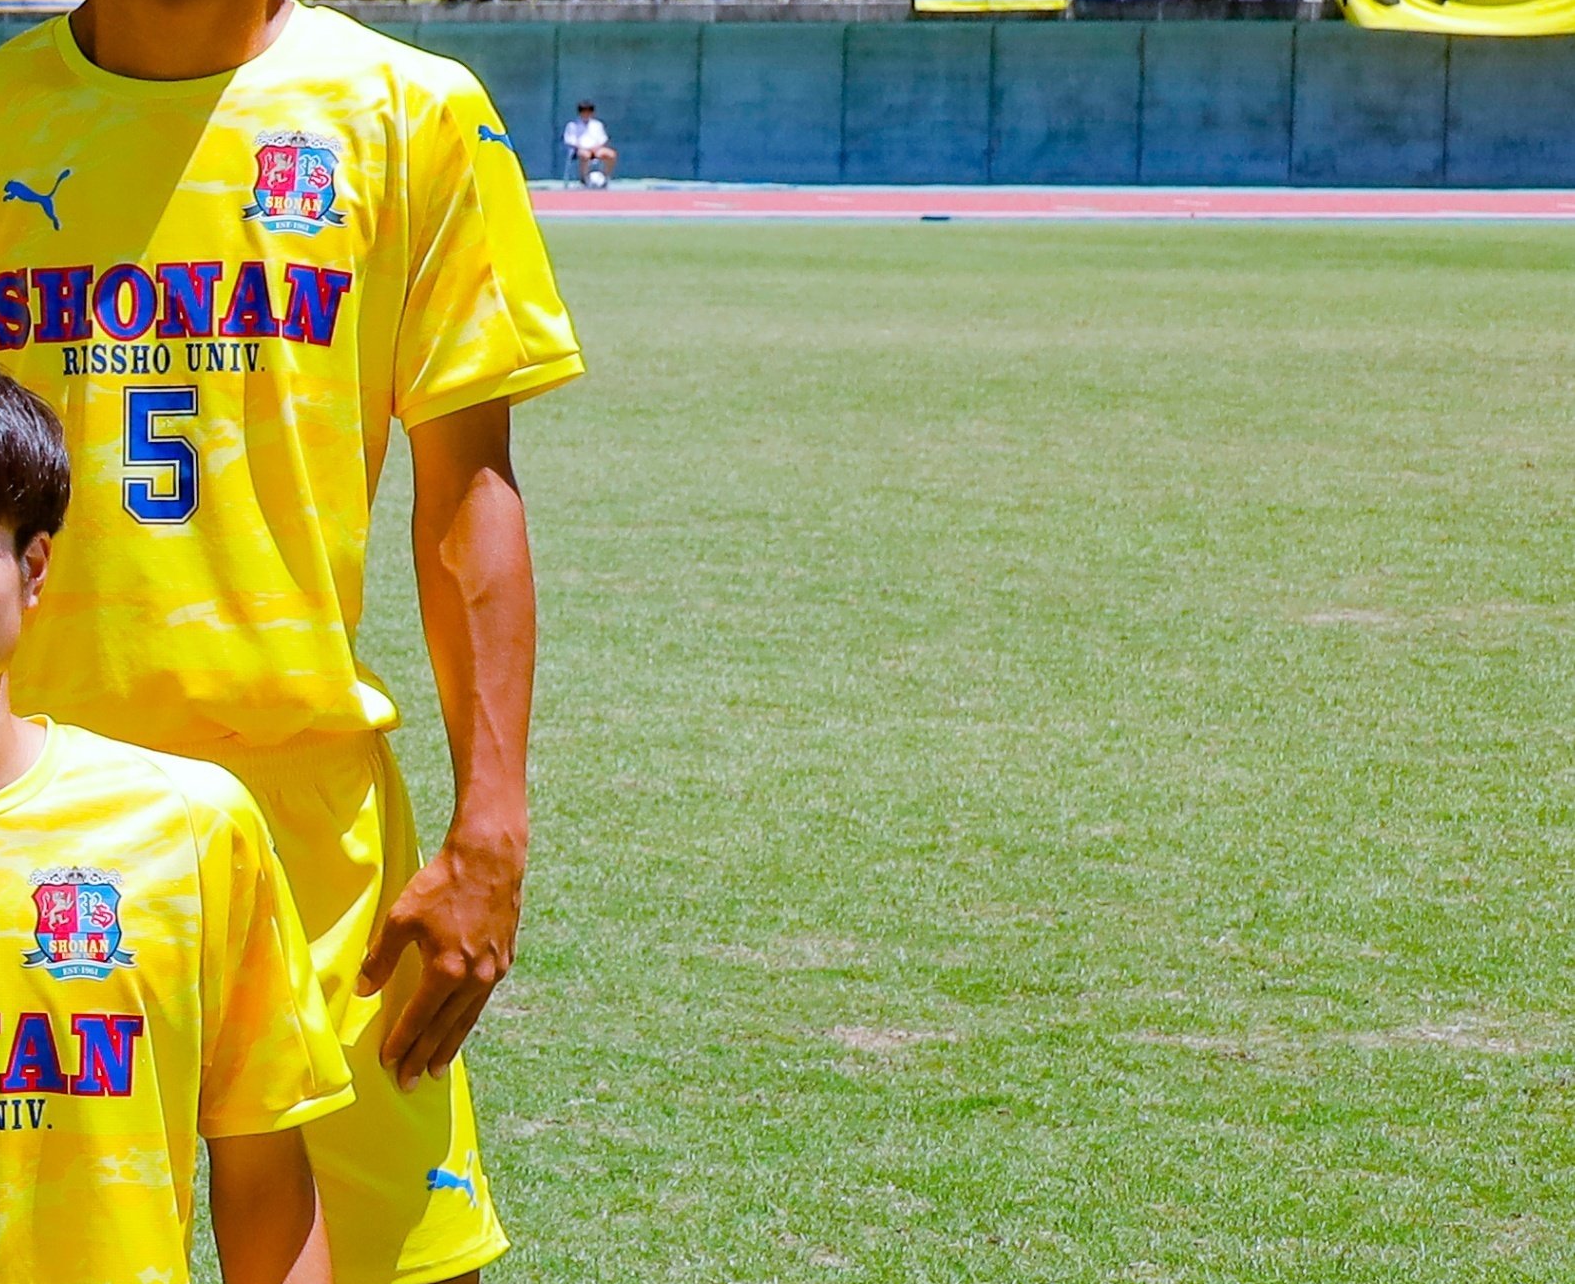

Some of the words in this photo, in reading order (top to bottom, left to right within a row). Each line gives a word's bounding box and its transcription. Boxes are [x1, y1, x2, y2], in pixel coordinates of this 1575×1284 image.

[265, 195, 324, 212] SHONAN
[62, 344, 171, 376] RISSHO
[186, 343, 265, 372] UNIV.
[122, 384, 198, 525] 5
[48, 938, 109, 954] SHONAN
